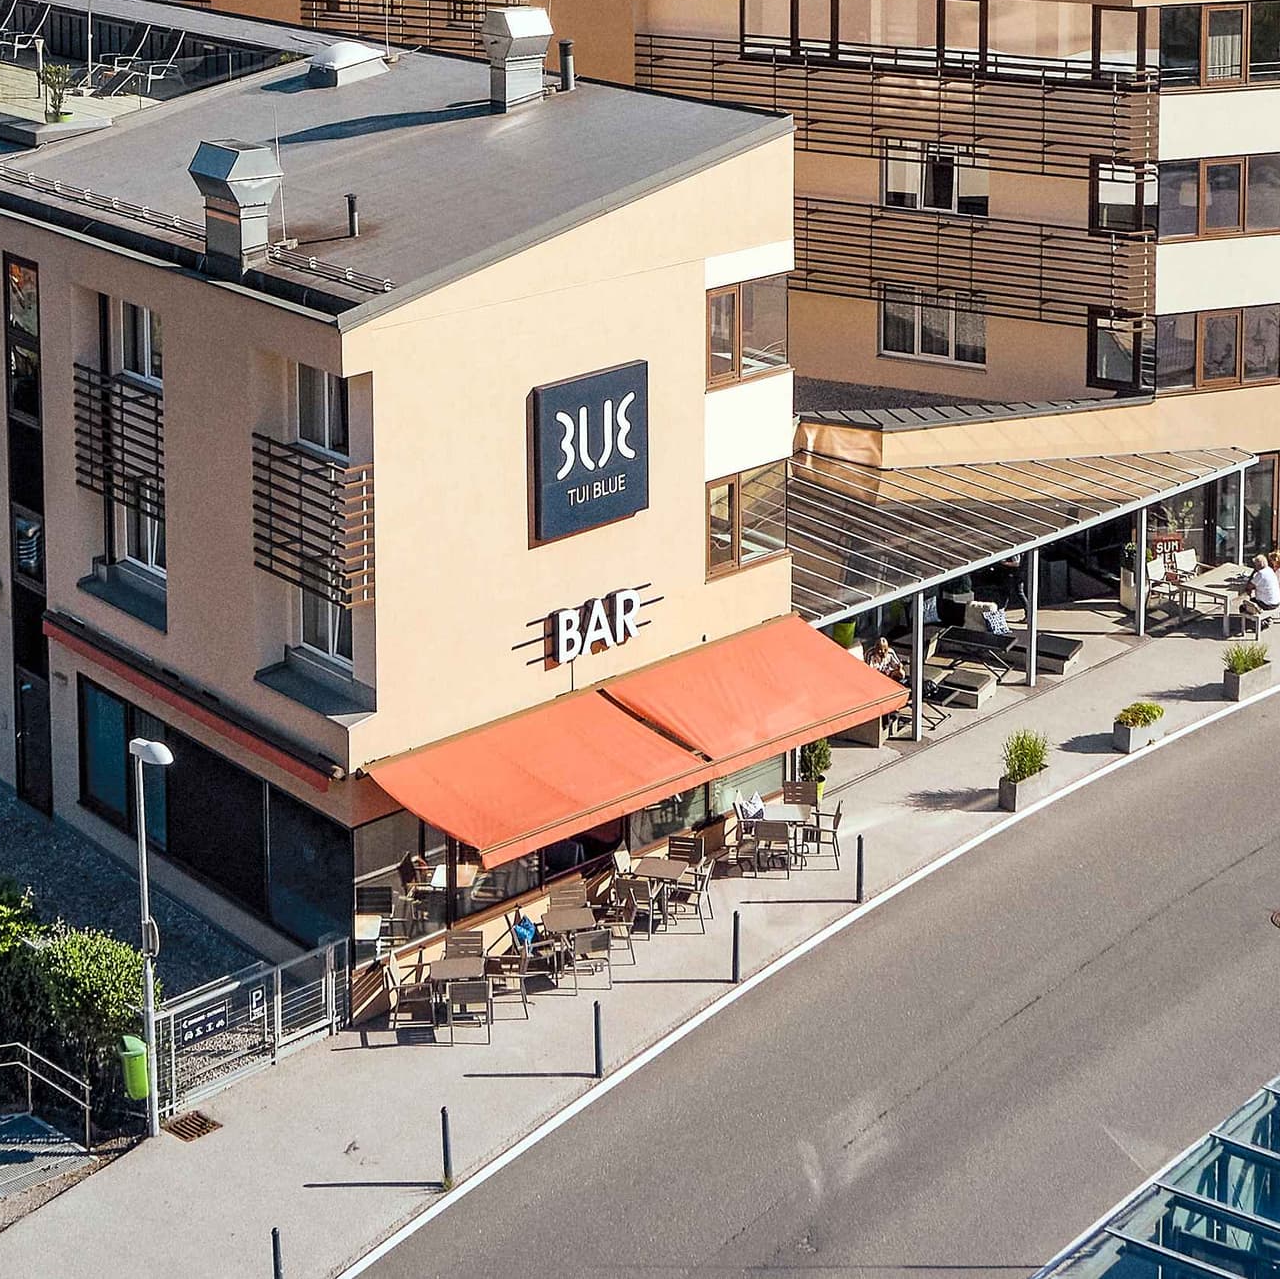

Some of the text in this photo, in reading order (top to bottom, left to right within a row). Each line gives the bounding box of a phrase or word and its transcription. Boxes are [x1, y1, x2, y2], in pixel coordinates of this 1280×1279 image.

[567, 473, 626, 506] TUI BLUE
[558, 588, 640, 664] BAR
[252, 989, 263, 1009] P
